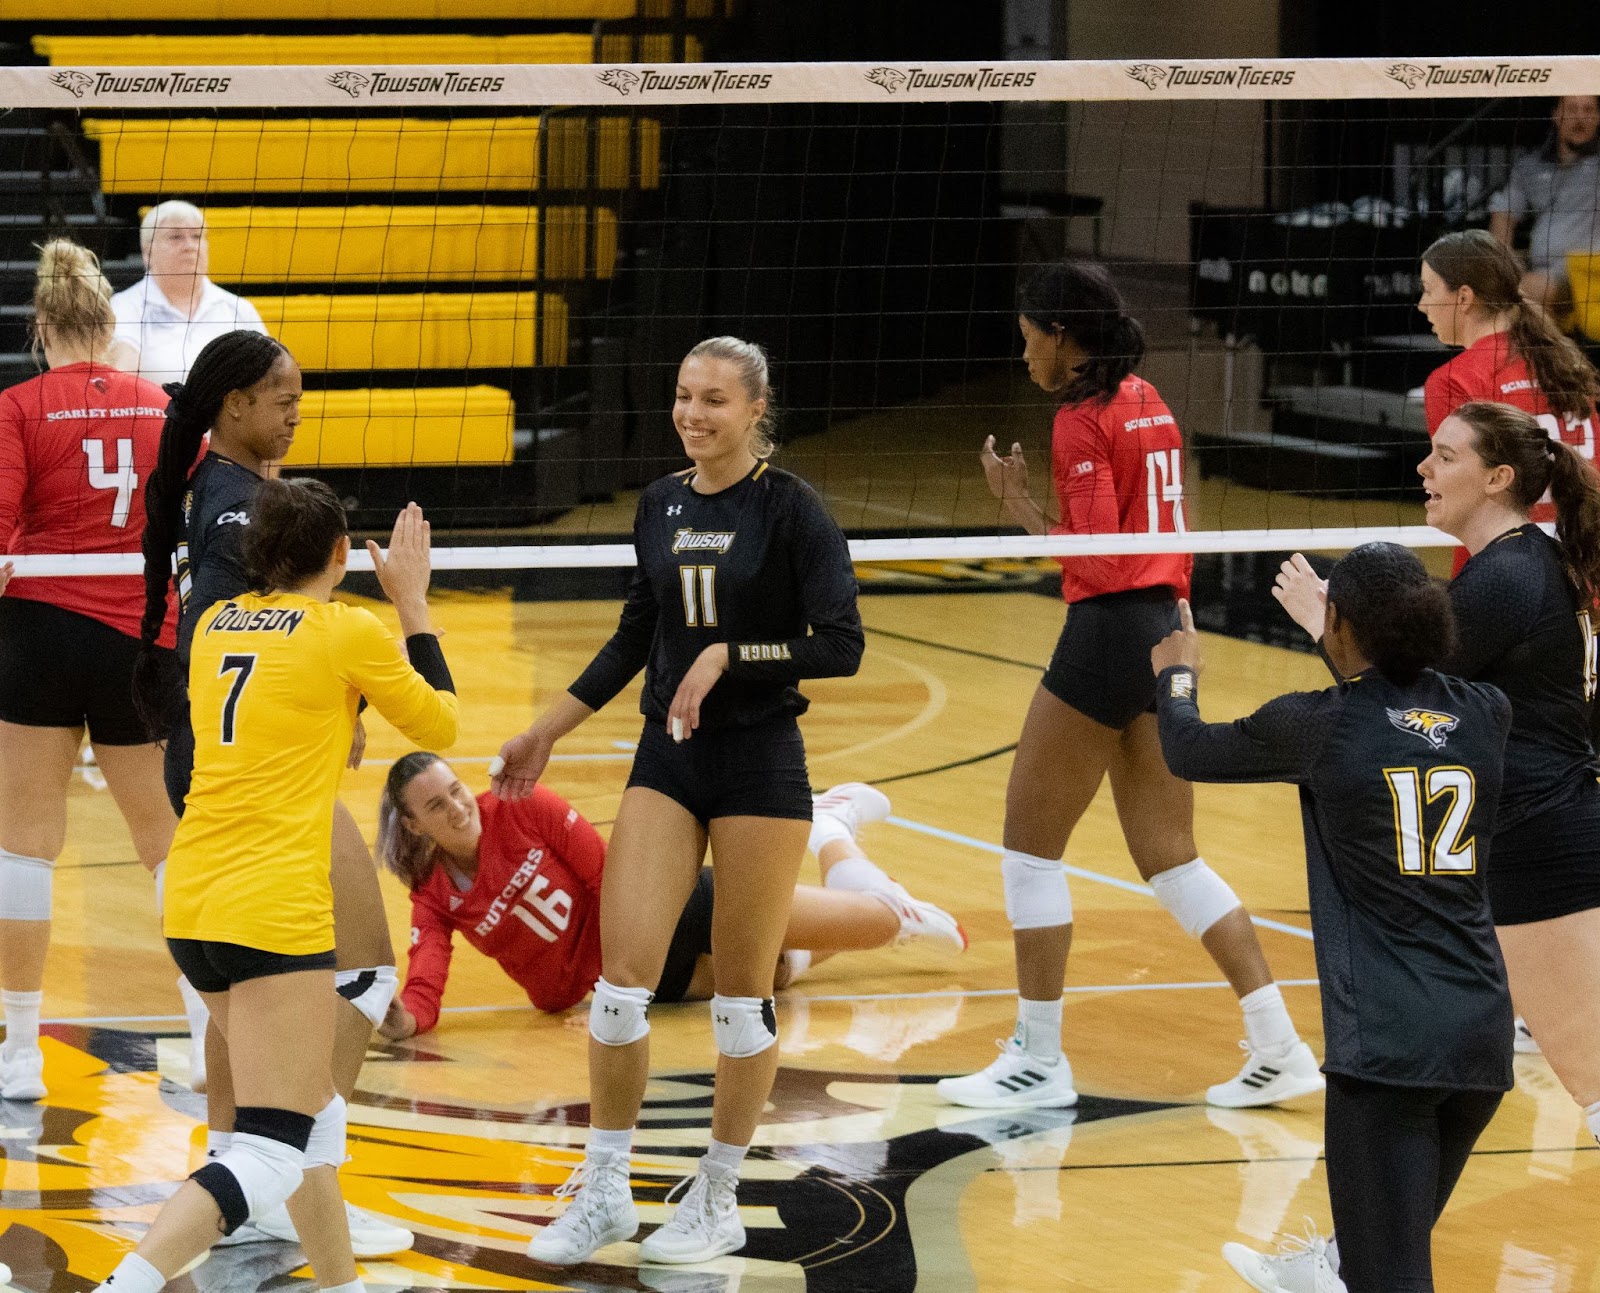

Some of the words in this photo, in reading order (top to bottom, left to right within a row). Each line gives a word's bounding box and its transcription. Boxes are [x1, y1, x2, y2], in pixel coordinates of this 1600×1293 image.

[46, 407, 108, 422] SCARLET
[82, 438, 138, 529] 4
[1146, 448, 1186, 533] 14
[217, 511, 250, 526] CA
[672, 527, 737, 555] TOWSON
[206, 603, 305, 638] TOWSON
[679, 565, 718, 627] 11
[738, 642, 792, 662] TOUGH
[217, 652, 259, 746] 7
[1382, 765, 1476, 875] 12
[474, 847, 544, 937] RUTGERS
[509, 873, 573, 943] 16
